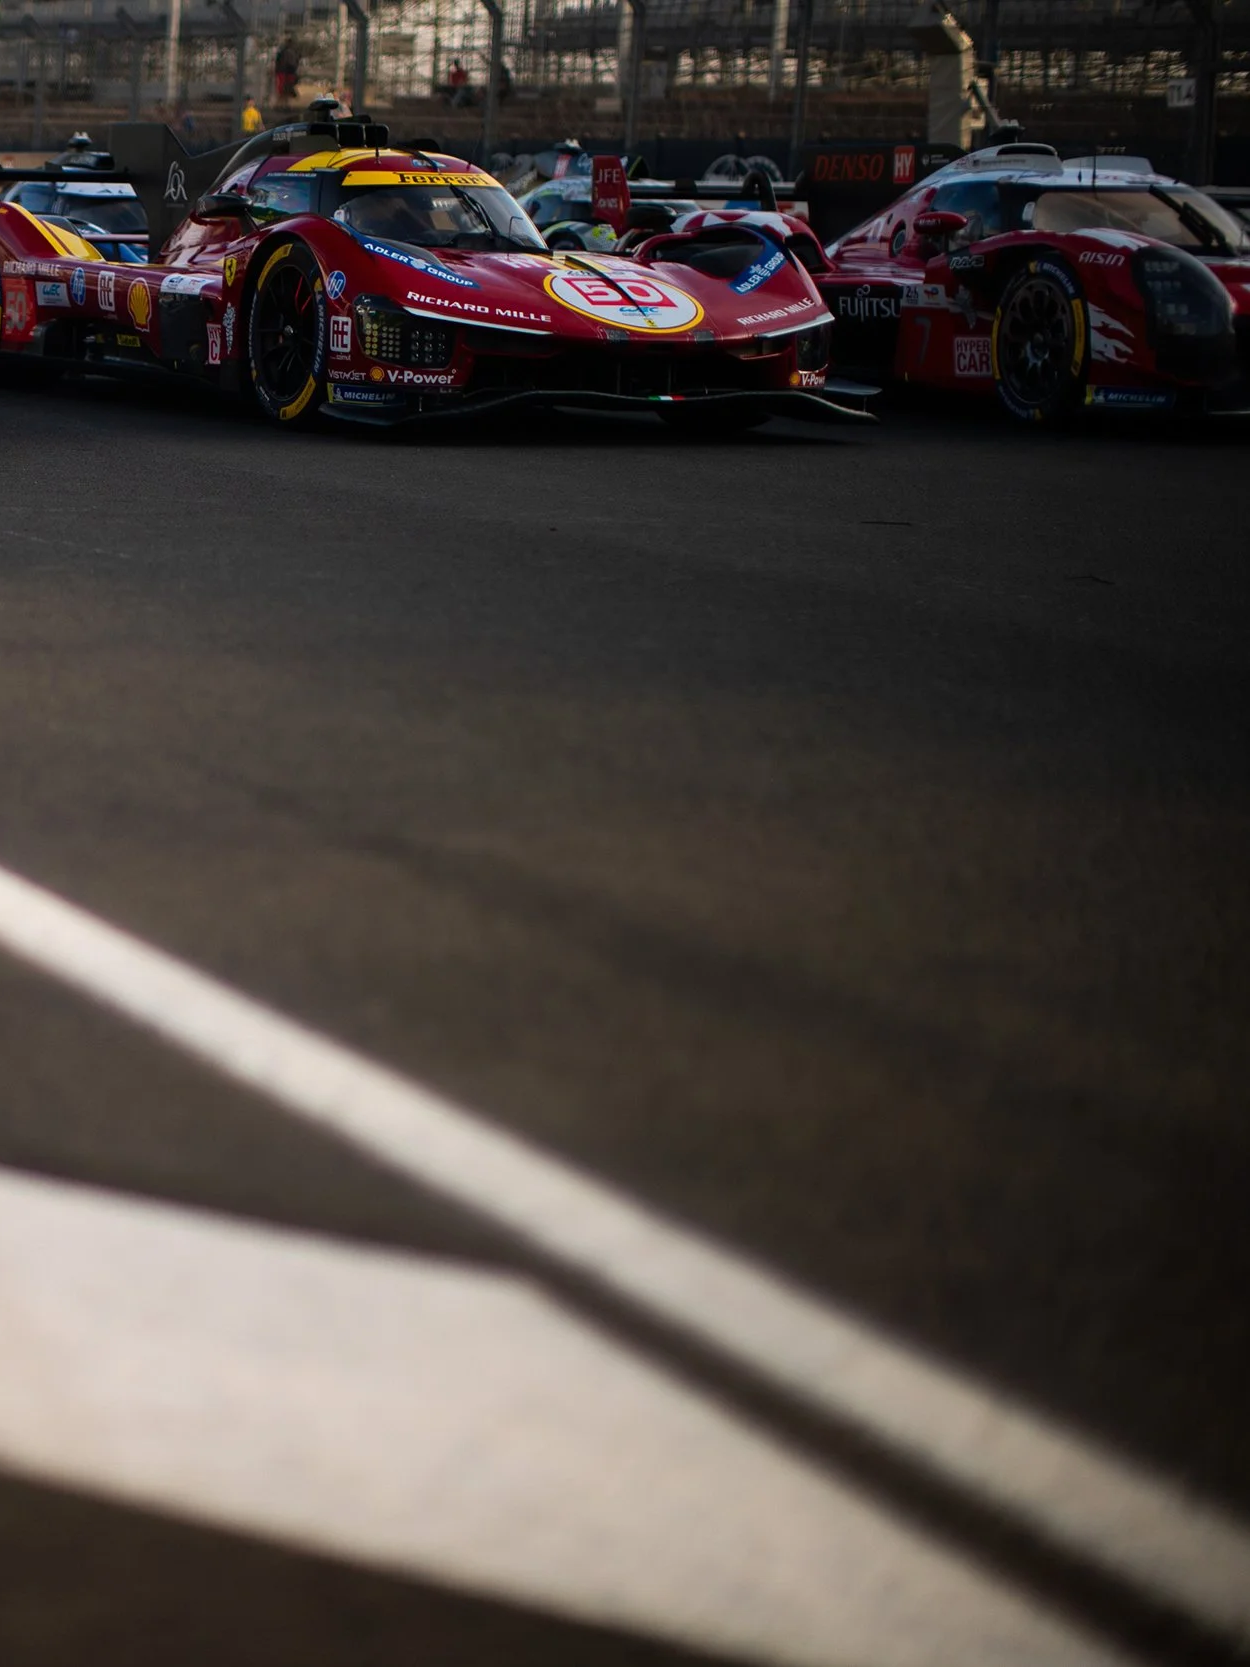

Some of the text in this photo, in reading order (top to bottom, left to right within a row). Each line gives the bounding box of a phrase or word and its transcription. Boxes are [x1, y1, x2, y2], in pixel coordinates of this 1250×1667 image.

[814, 153, 885, 181] DENSO
[893, 153, 913, 178] HY
[398, 172, 490, 185] Ferrari
[3, 261, 60, 277] RICHARD MILLE
[364, 242, 473, 287] ADLER GROUP
[1078, 251, 1125, 266] AISIN
[736, 251, 786, 293] ADLER GROUP
[42, 284, 60, 296] WEC
[328, 271, 346, 299] hp
[576, 279, 664, 303] 50
[5, 290, 27, 335] 50
[406, 291, 552, 322] RICHARD MILLE
[737, 297, 815, 326] RICHARD MILLE
[914, 316, 931, 366] 7
[956, 339, 990, 351] HYPER
[957, 353, 990, 373] CAR
[387, 369, 455, 384] V-Power
[344, 391, 396, 401] MICHELIN
[1107, 393, 1166, 402] MICHELIN
